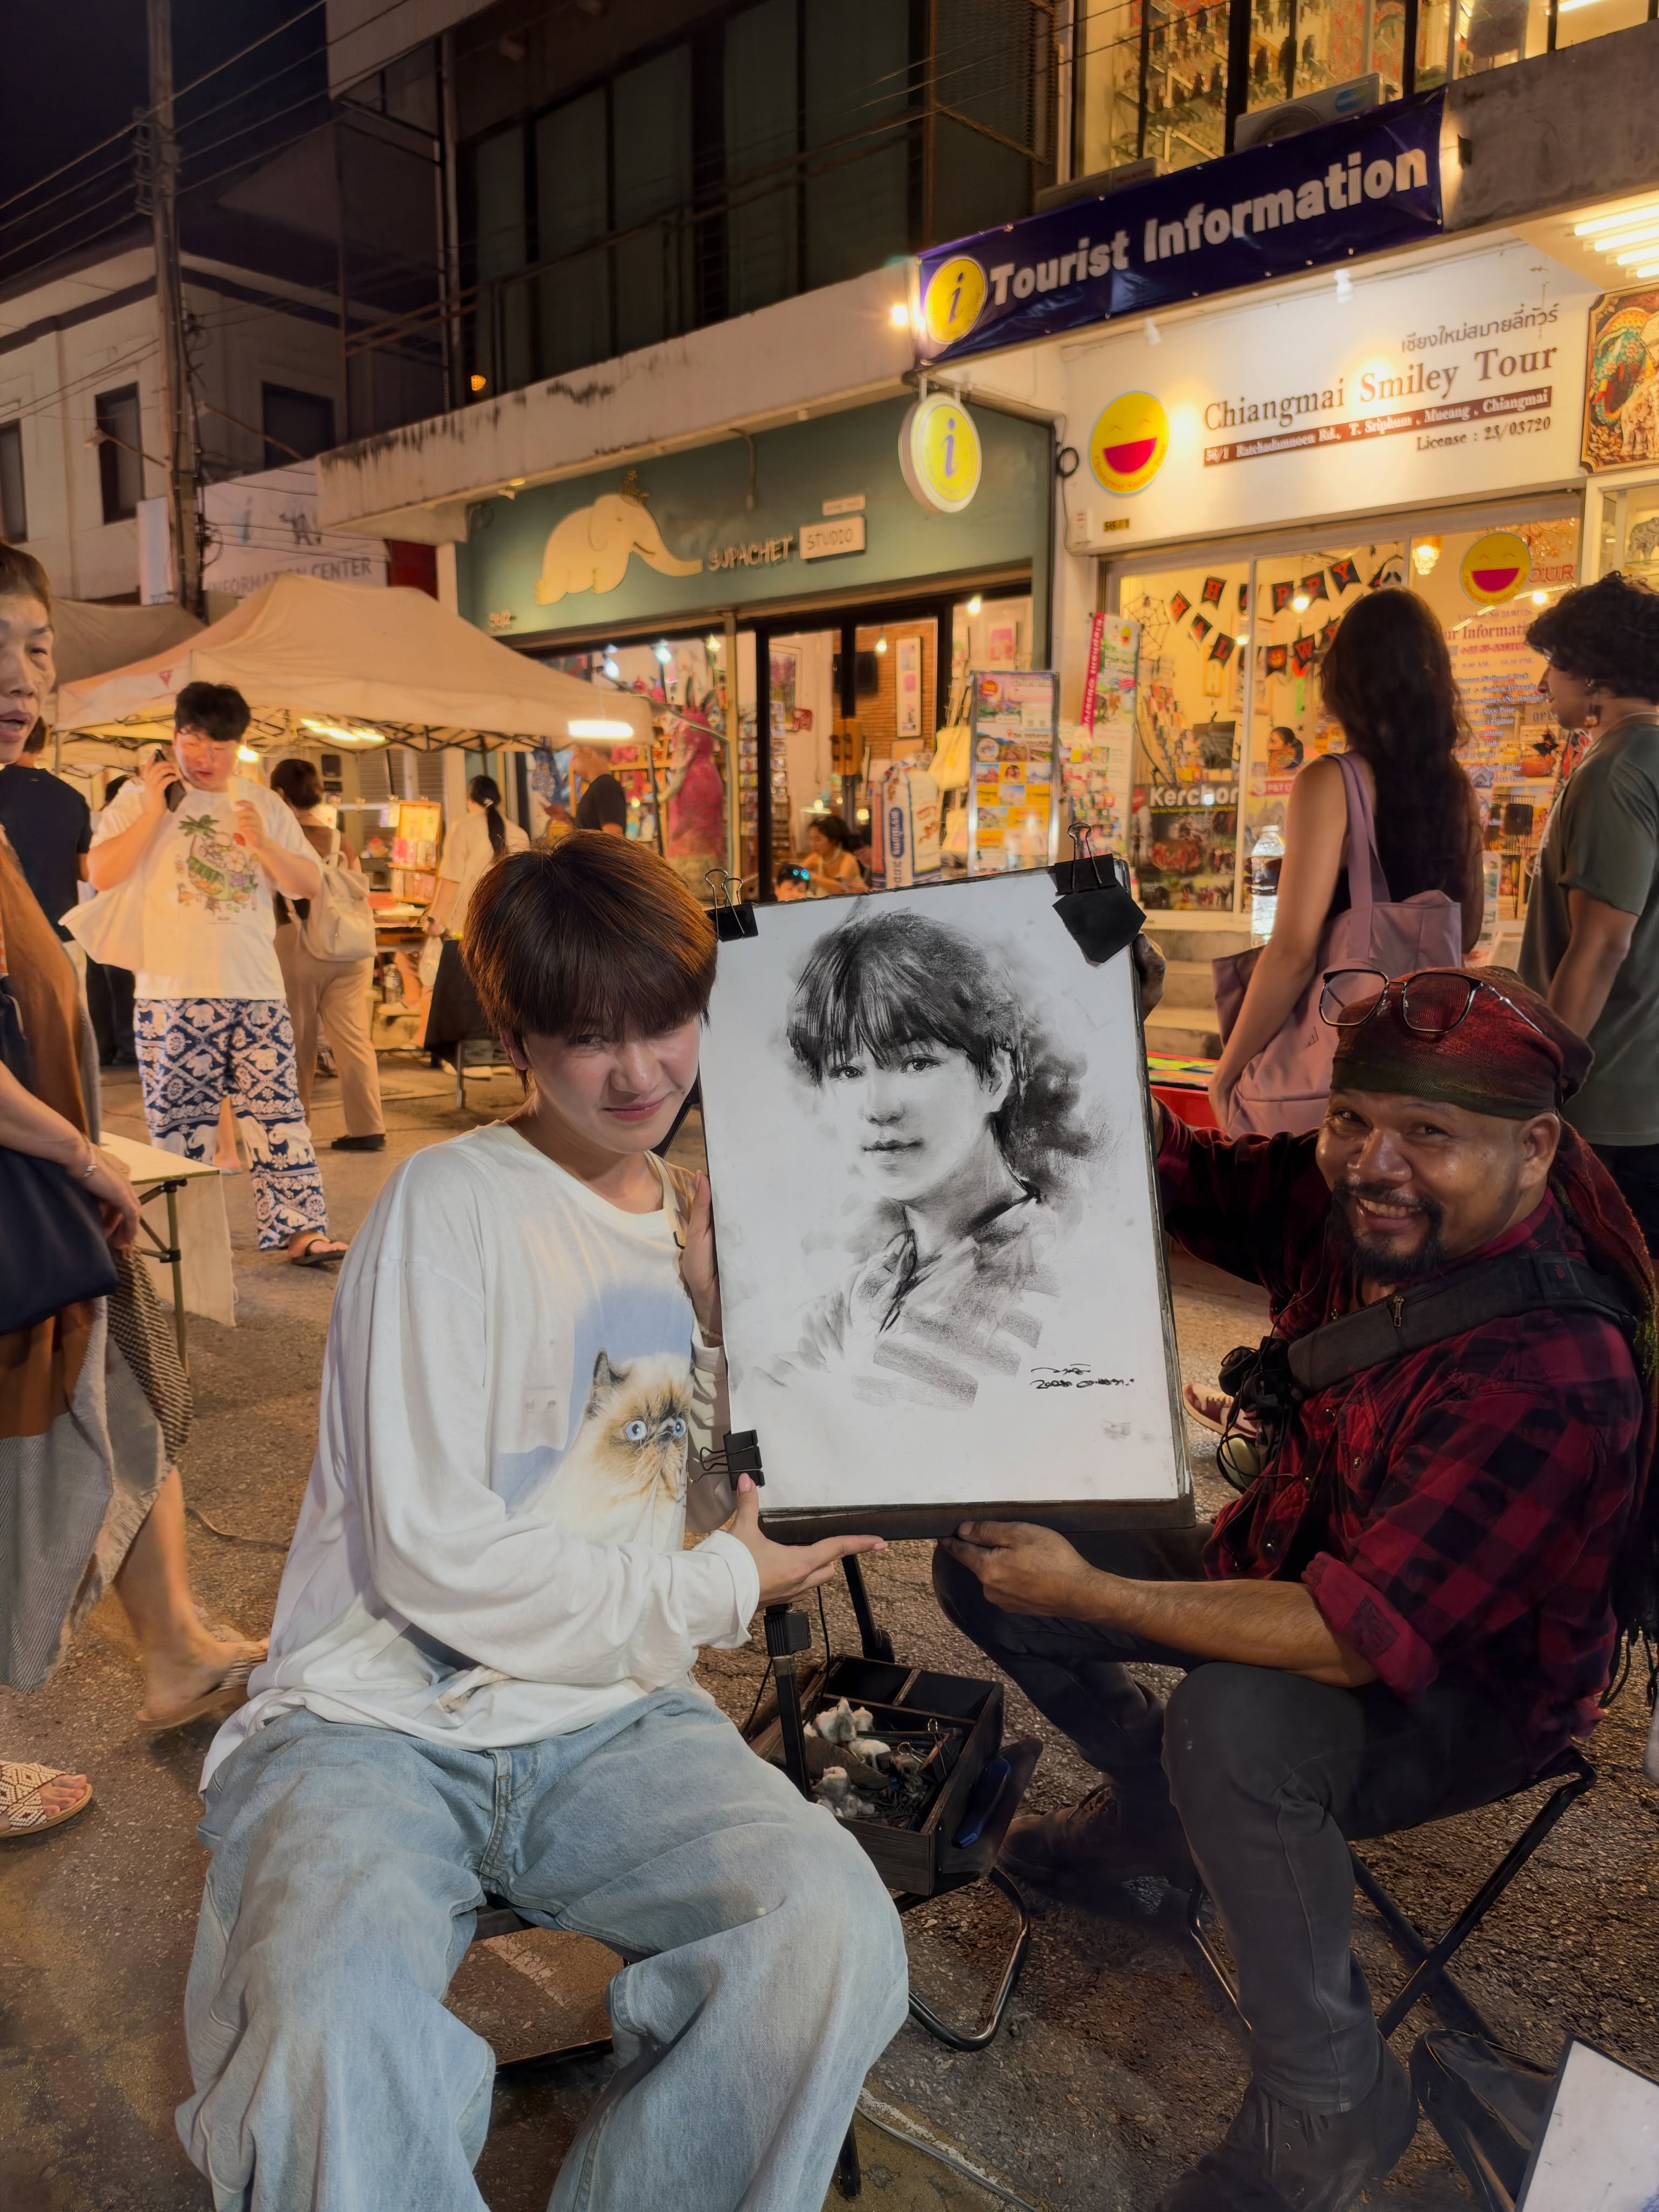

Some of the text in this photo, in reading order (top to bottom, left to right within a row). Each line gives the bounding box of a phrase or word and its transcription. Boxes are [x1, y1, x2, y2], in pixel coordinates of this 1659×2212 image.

[990, 146, 1428, 306] Tourist Information
[1204, 346, 1557, 430] Chiangmai Smiley Tour
[1417, 434, 1467, 450] License
[807, 527, 855, 550] STUDIO
[708, 533, 795, 571] SUPACHET
[311, 558, 372, 579] CENTER
[1527, 564, 1575, 584] OUR
